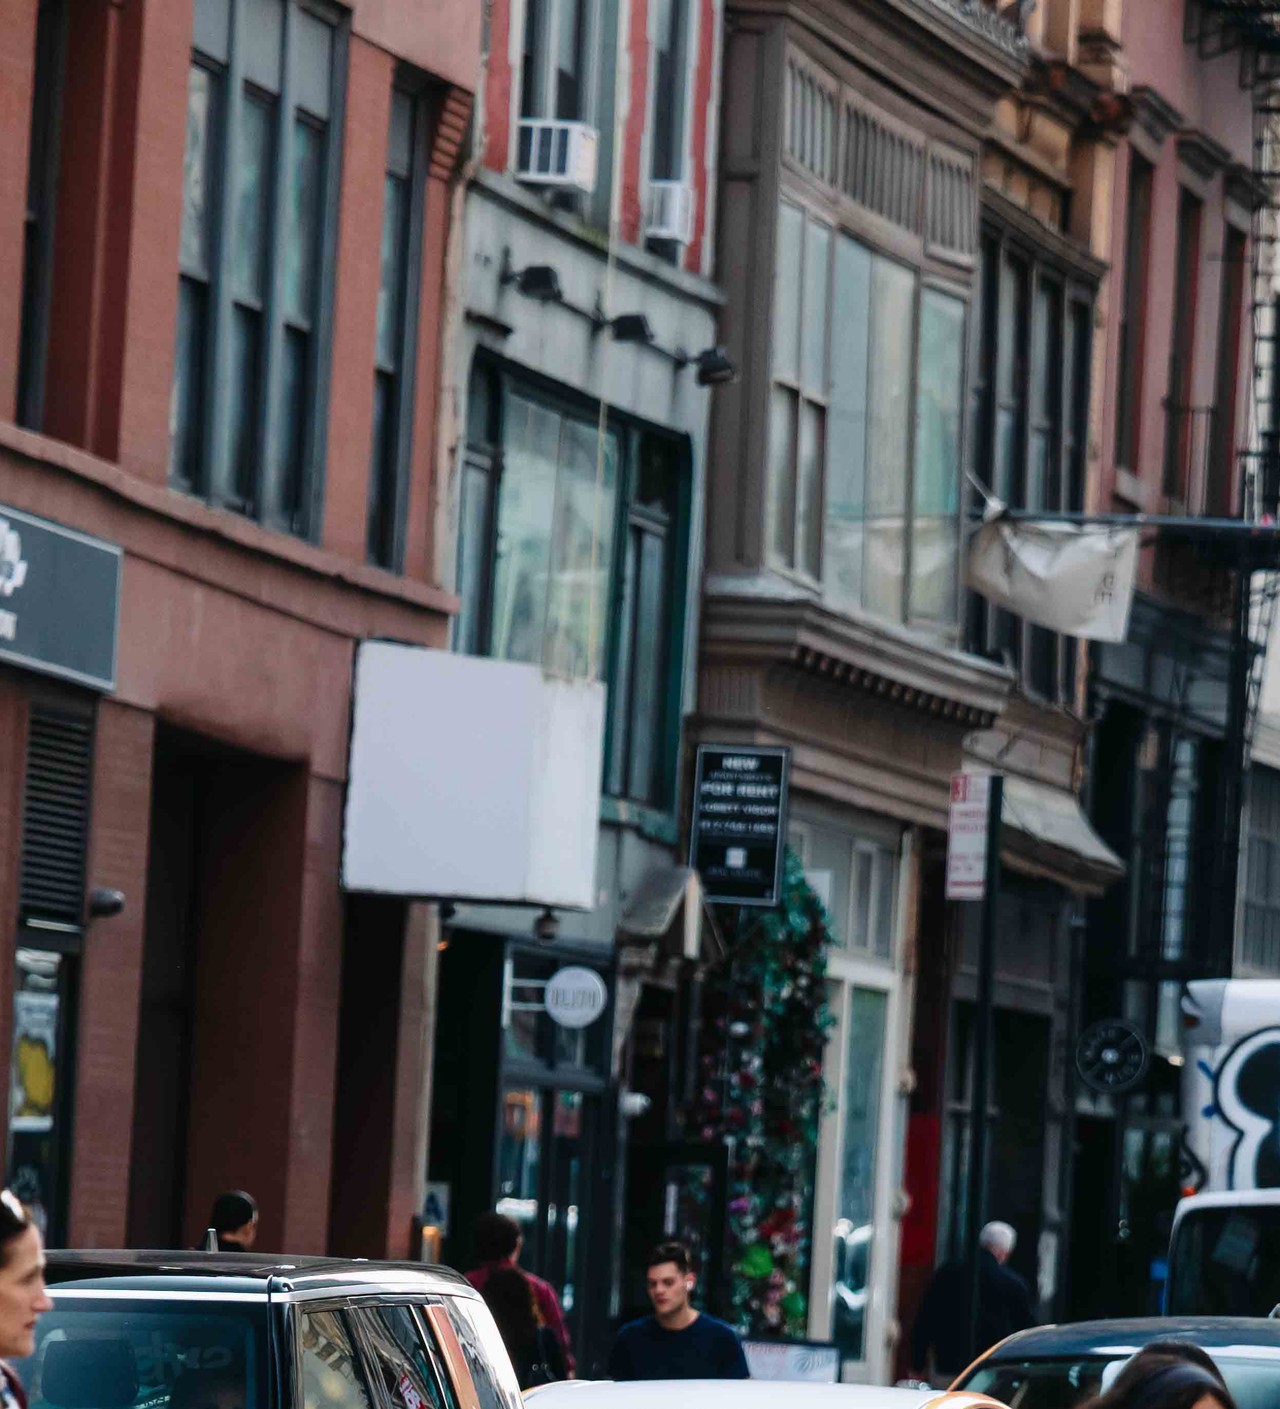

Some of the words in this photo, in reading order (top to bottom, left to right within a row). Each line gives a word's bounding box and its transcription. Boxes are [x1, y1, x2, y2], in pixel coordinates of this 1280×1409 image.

[722, 756, 760, 770] NEW
[700, 780, 734, 797] FOR
[736, 783, 779, 799] RENT
